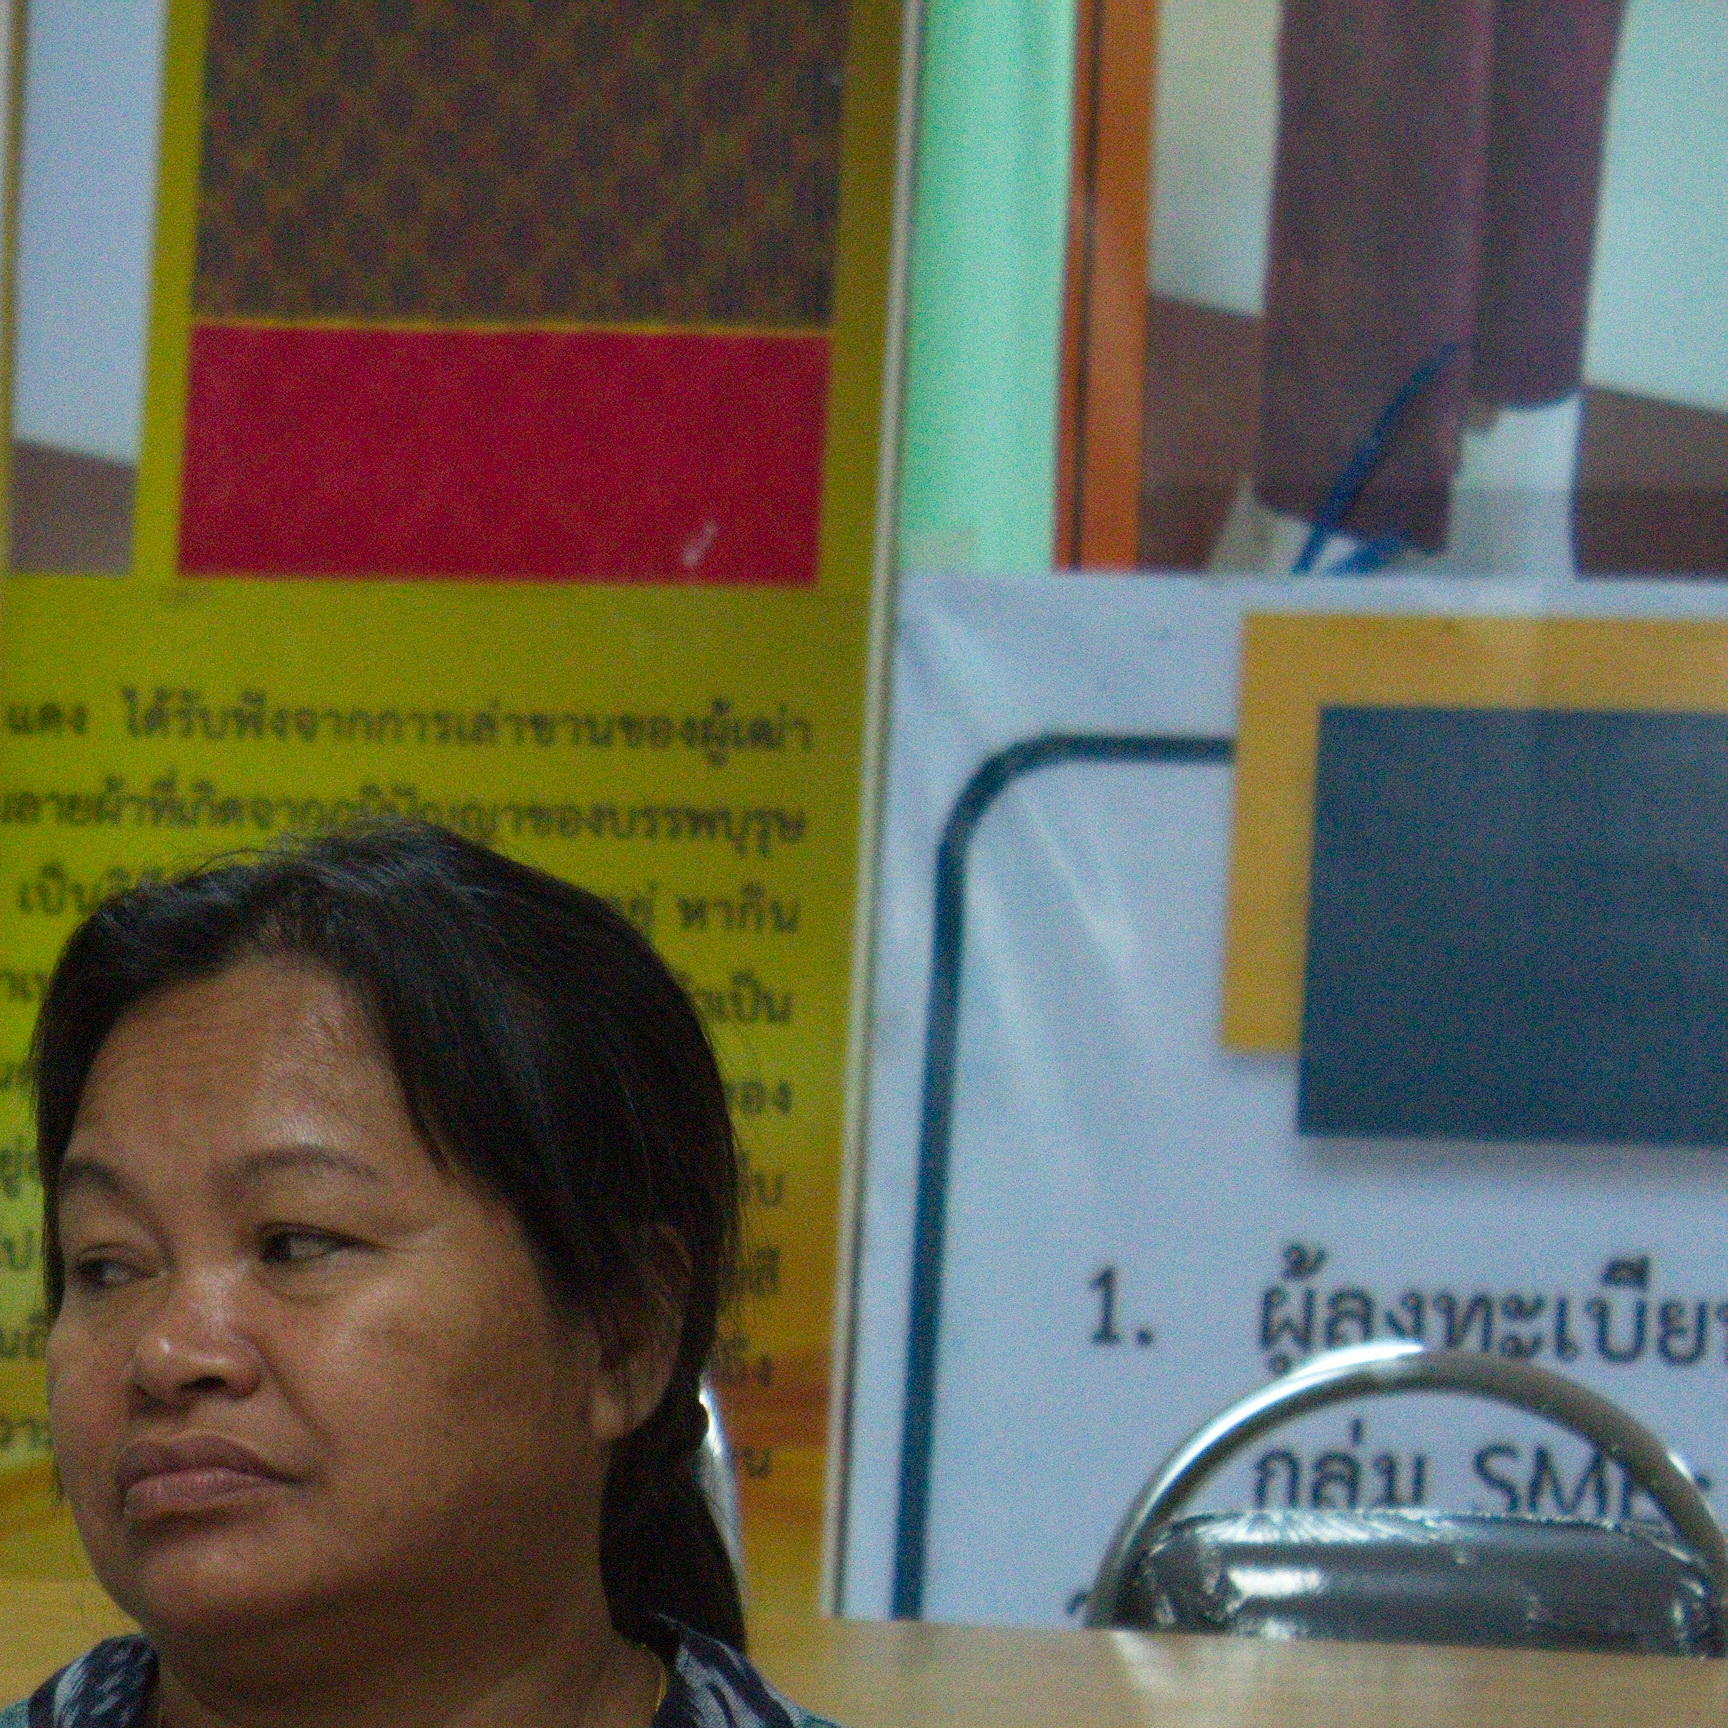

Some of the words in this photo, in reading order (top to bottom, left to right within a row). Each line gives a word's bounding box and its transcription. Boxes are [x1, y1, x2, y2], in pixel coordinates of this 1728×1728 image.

[1087, 1263, 1155, 1348] 1.
[1257, 1242, 1728, 1378] ผู้ลงทะเบีย
